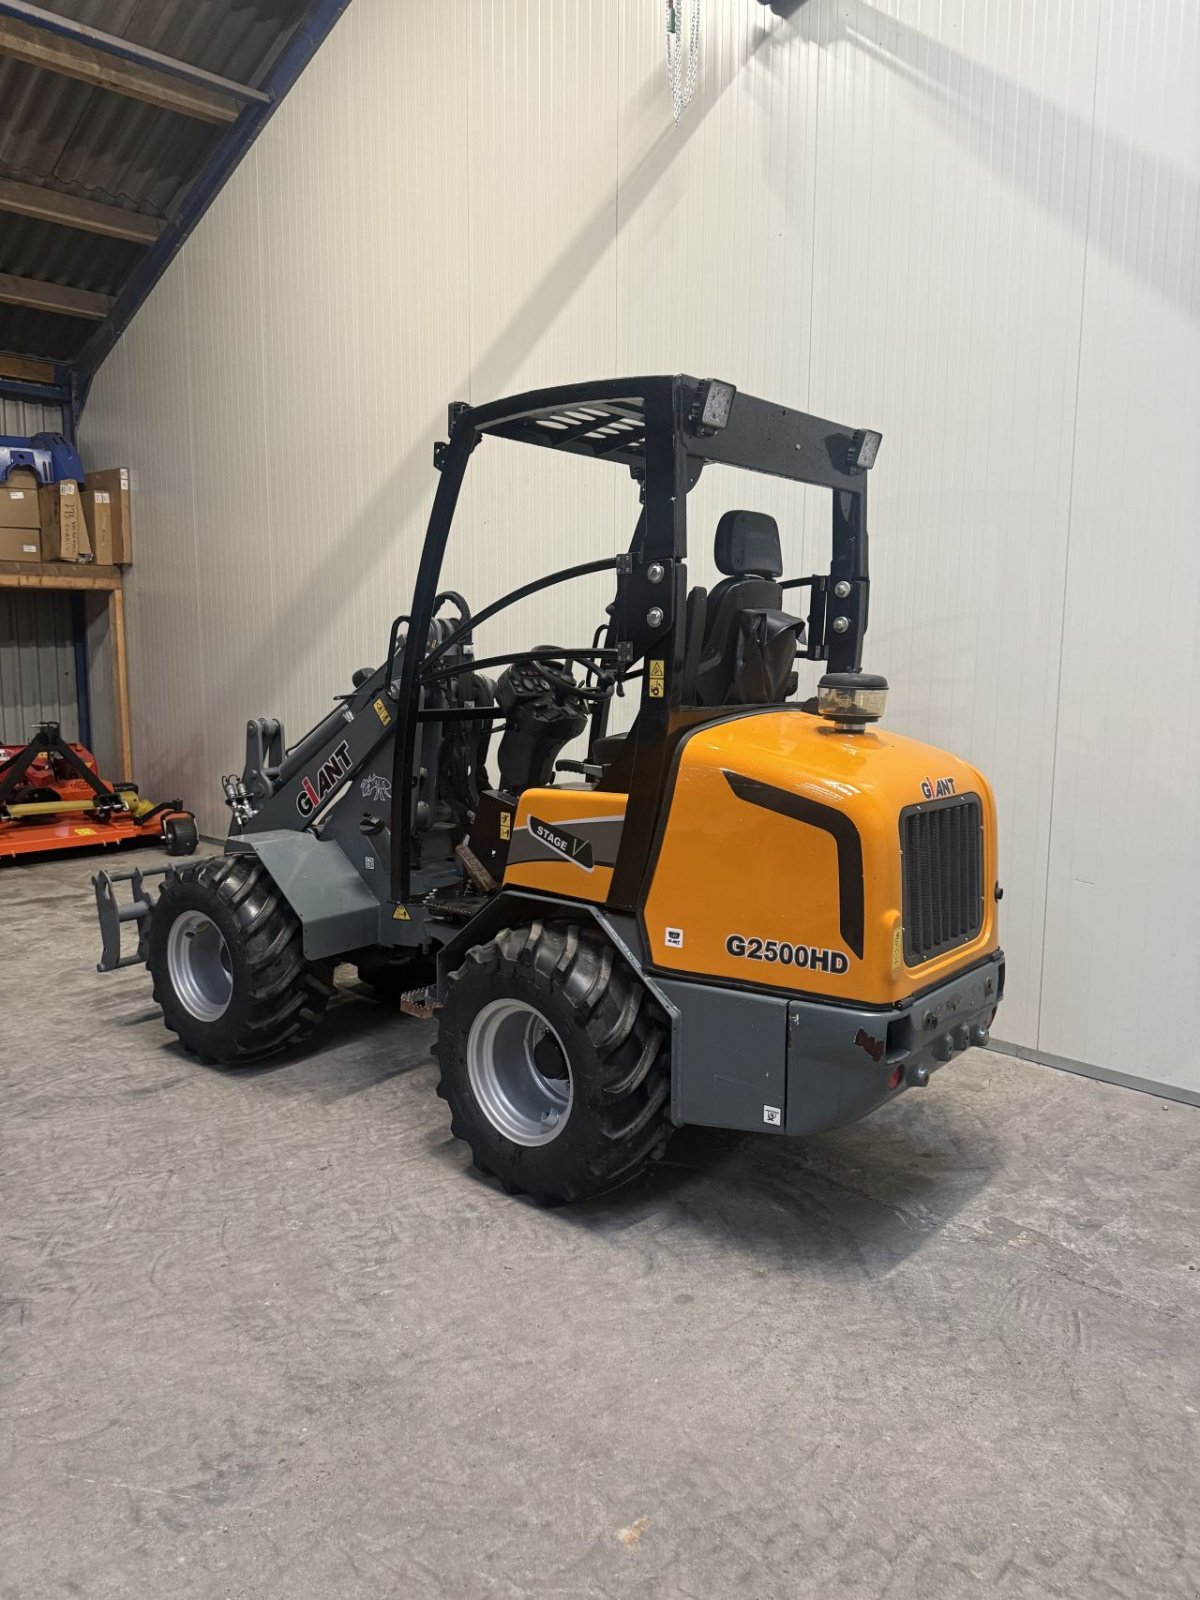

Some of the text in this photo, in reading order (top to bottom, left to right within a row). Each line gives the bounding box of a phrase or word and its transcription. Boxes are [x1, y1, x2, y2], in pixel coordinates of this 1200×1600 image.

[536, 825, 590, 856] STAGE V
[725, 933, 850, 975] G2500HD
